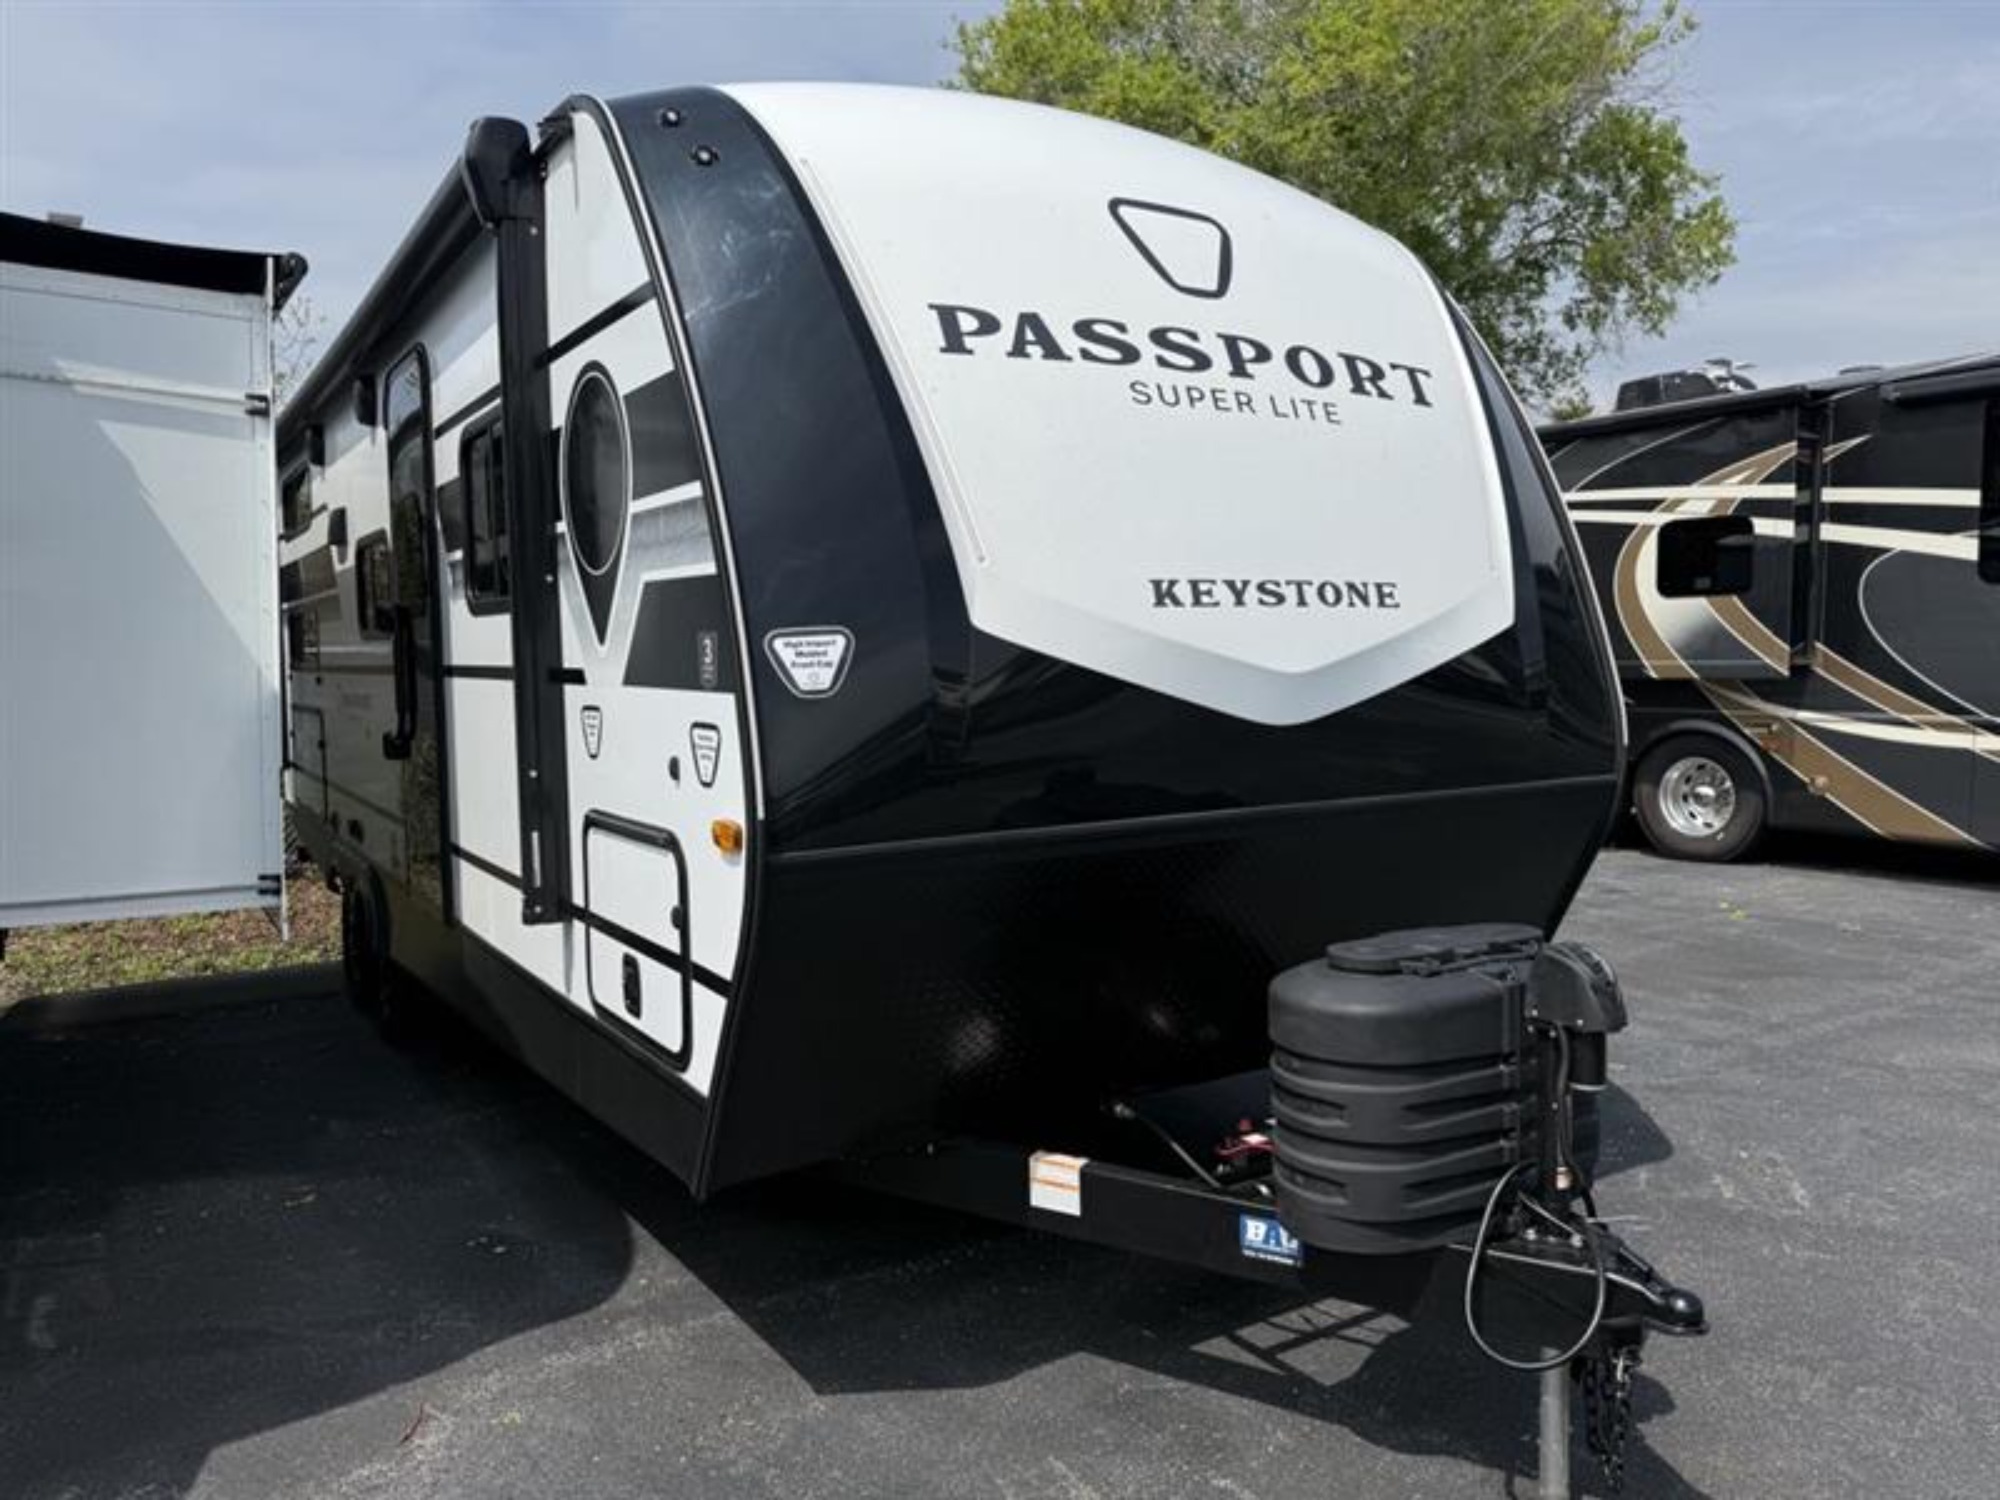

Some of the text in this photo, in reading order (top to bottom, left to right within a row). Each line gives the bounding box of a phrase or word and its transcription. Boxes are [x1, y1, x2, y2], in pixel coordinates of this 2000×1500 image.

[927, 303, 1433, 407] PASSPORT
[1129, 380, 1342, 425] SUPER LITE
[1149, 578, 1401, 609] KEYSTONE
